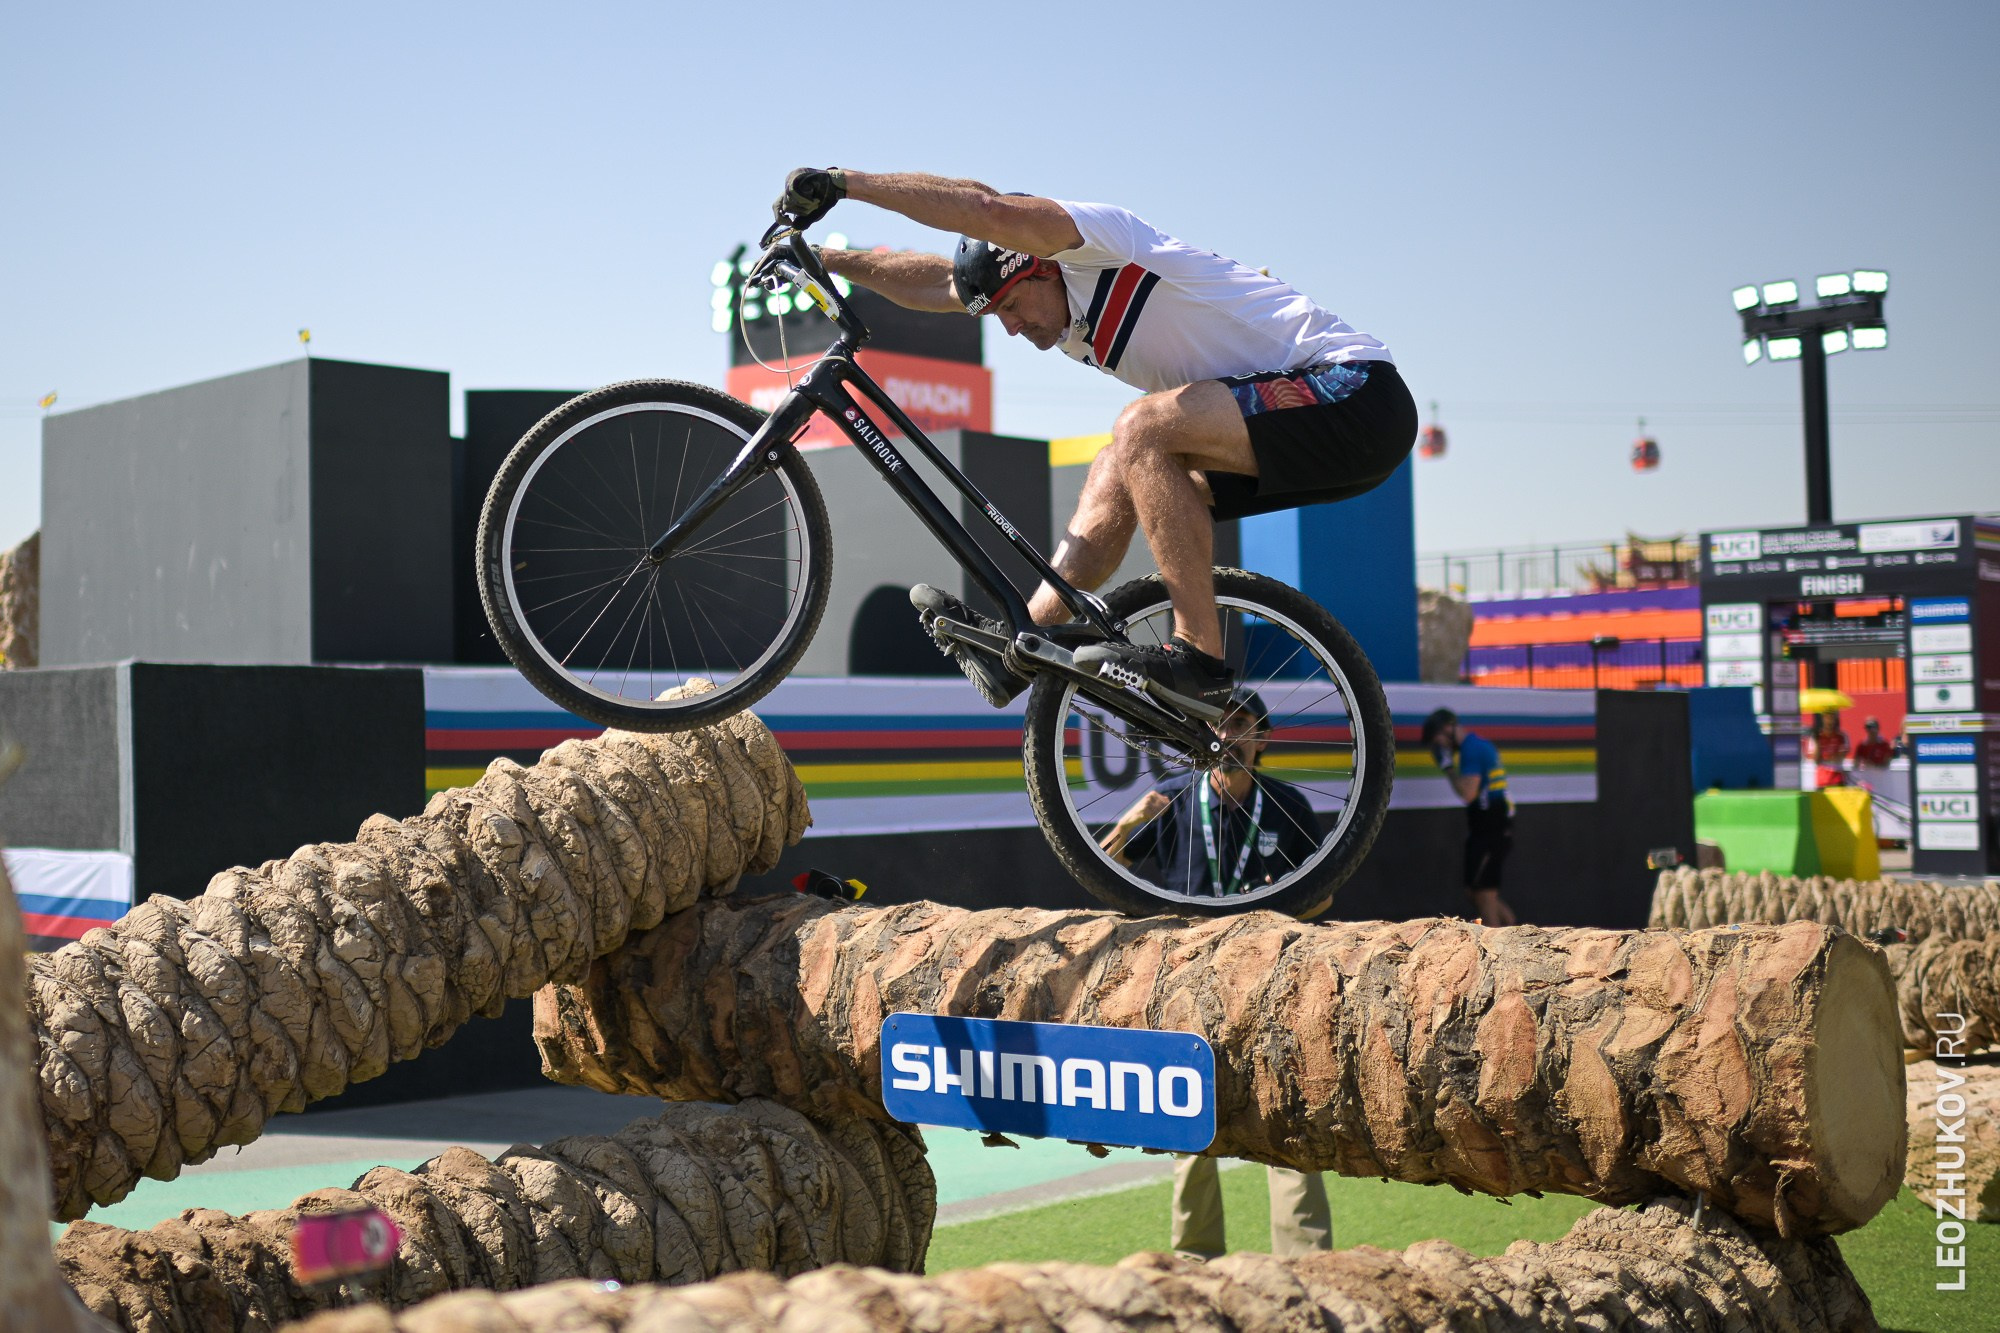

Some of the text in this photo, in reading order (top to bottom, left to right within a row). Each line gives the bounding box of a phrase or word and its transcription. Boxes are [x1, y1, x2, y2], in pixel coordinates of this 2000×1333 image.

[966, 293, 991, 316] ALTROCK
[853, 418, 902, 473] SALTROCK
[1719, 540, 1755, 554] UCI
[1802, 574, 1863, 596] FINISH
[1719, 612, 1754, 624] UCI
[1912, 603, 1969, 618] SHIMANO
[1917, 742, 1974, 757] SHIMANO
[1930, 800, 1970, 816] UCI
[891, 1043, 1203, 1118] SHIMANO
